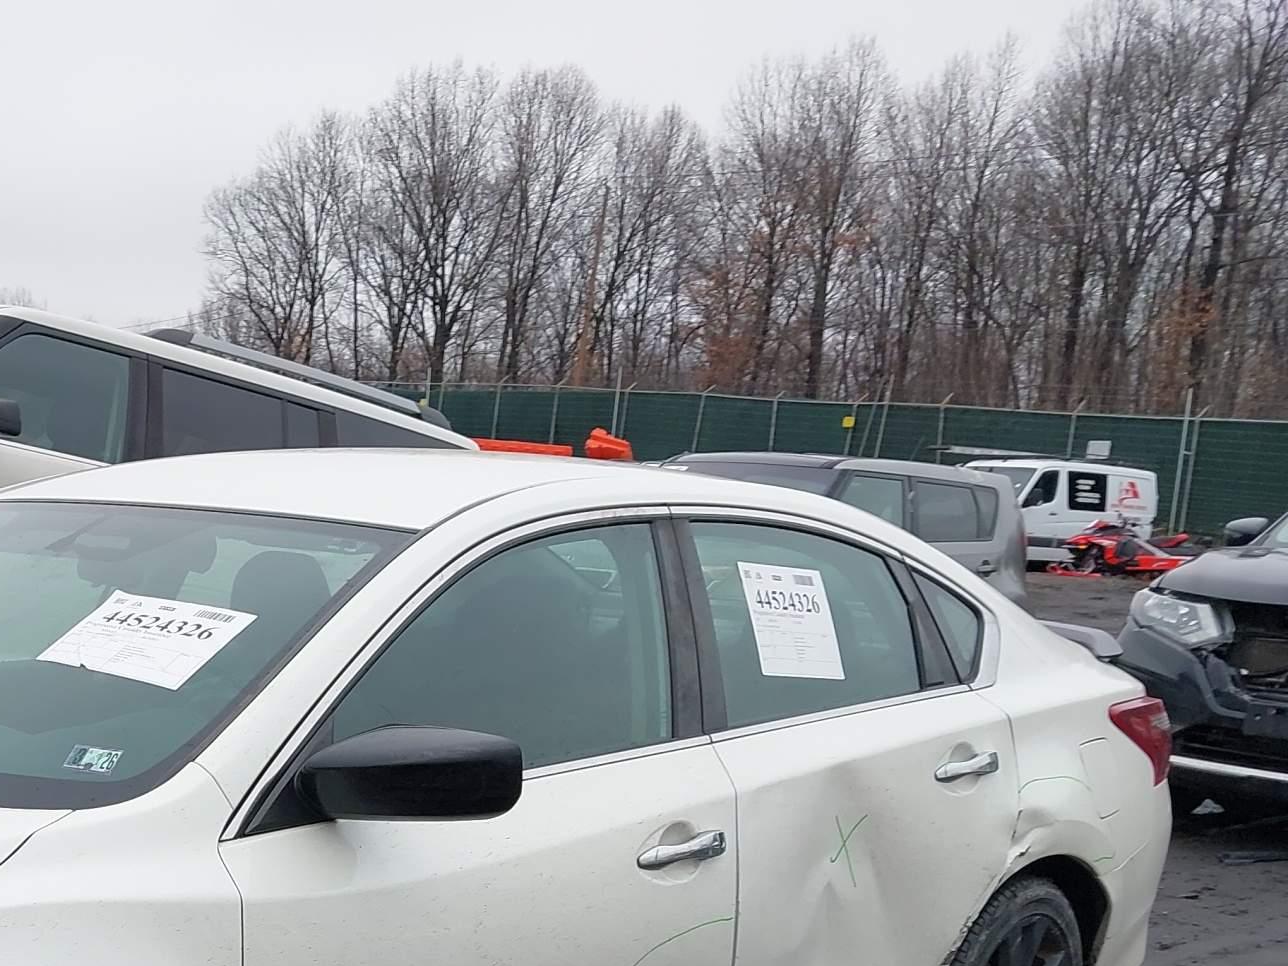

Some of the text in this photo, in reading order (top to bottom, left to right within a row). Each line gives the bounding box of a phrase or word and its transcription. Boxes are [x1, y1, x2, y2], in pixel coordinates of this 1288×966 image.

[756, 590, 821, 614] 44524326
[103, 611, 220, 640] 44524326
[99, 752, 119, 770] 26
